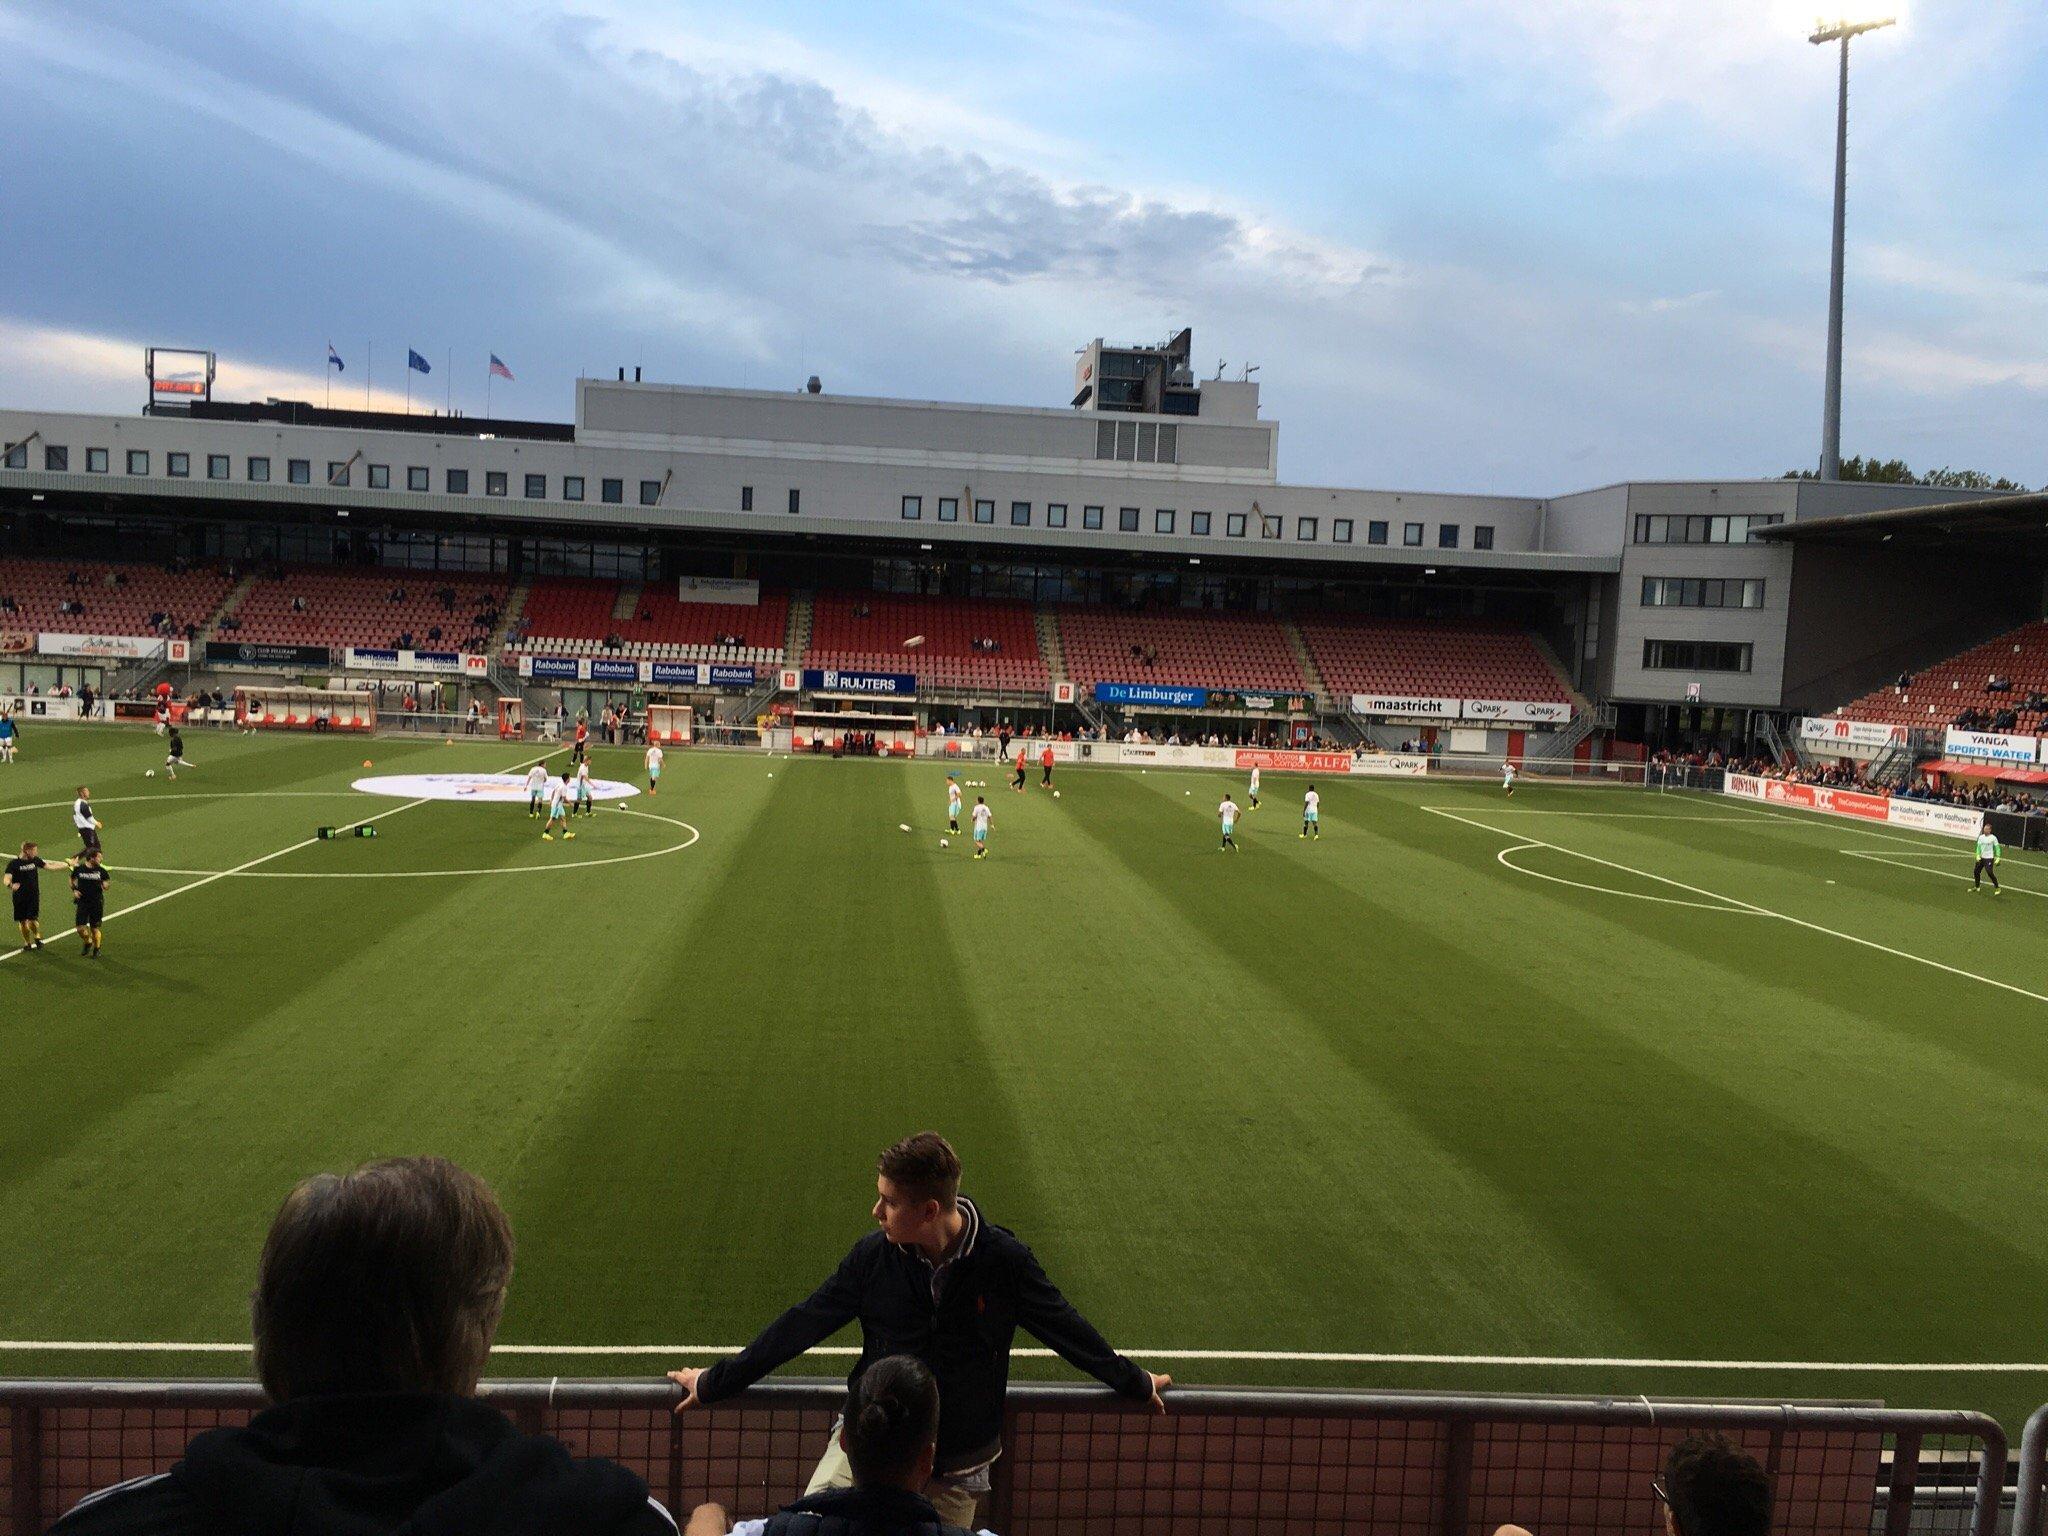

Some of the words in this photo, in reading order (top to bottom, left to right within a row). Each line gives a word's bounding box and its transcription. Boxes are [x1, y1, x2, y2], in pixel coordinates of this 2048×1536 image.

[535, 659, 577, 671] Rabobank
[594, 662, 635, 673] Rabobank
[655, 665, 696, 676] Rabobank
[713, 668, 753, 679] Rabobank
[840, 677, 896, 690] RUIJTERS
[1109, 686, 1127, 698] De
[1128, 687, 1194, 704] Limburger
[1971, 735, 2010, 747] YANGA
[1947, 744, 1989, 756] SPORTS
[1992, 748, 2032, 761] WATER
[1273, 759, 1312, 770] Company
[1312, 756, 1350, 769] ALFA
